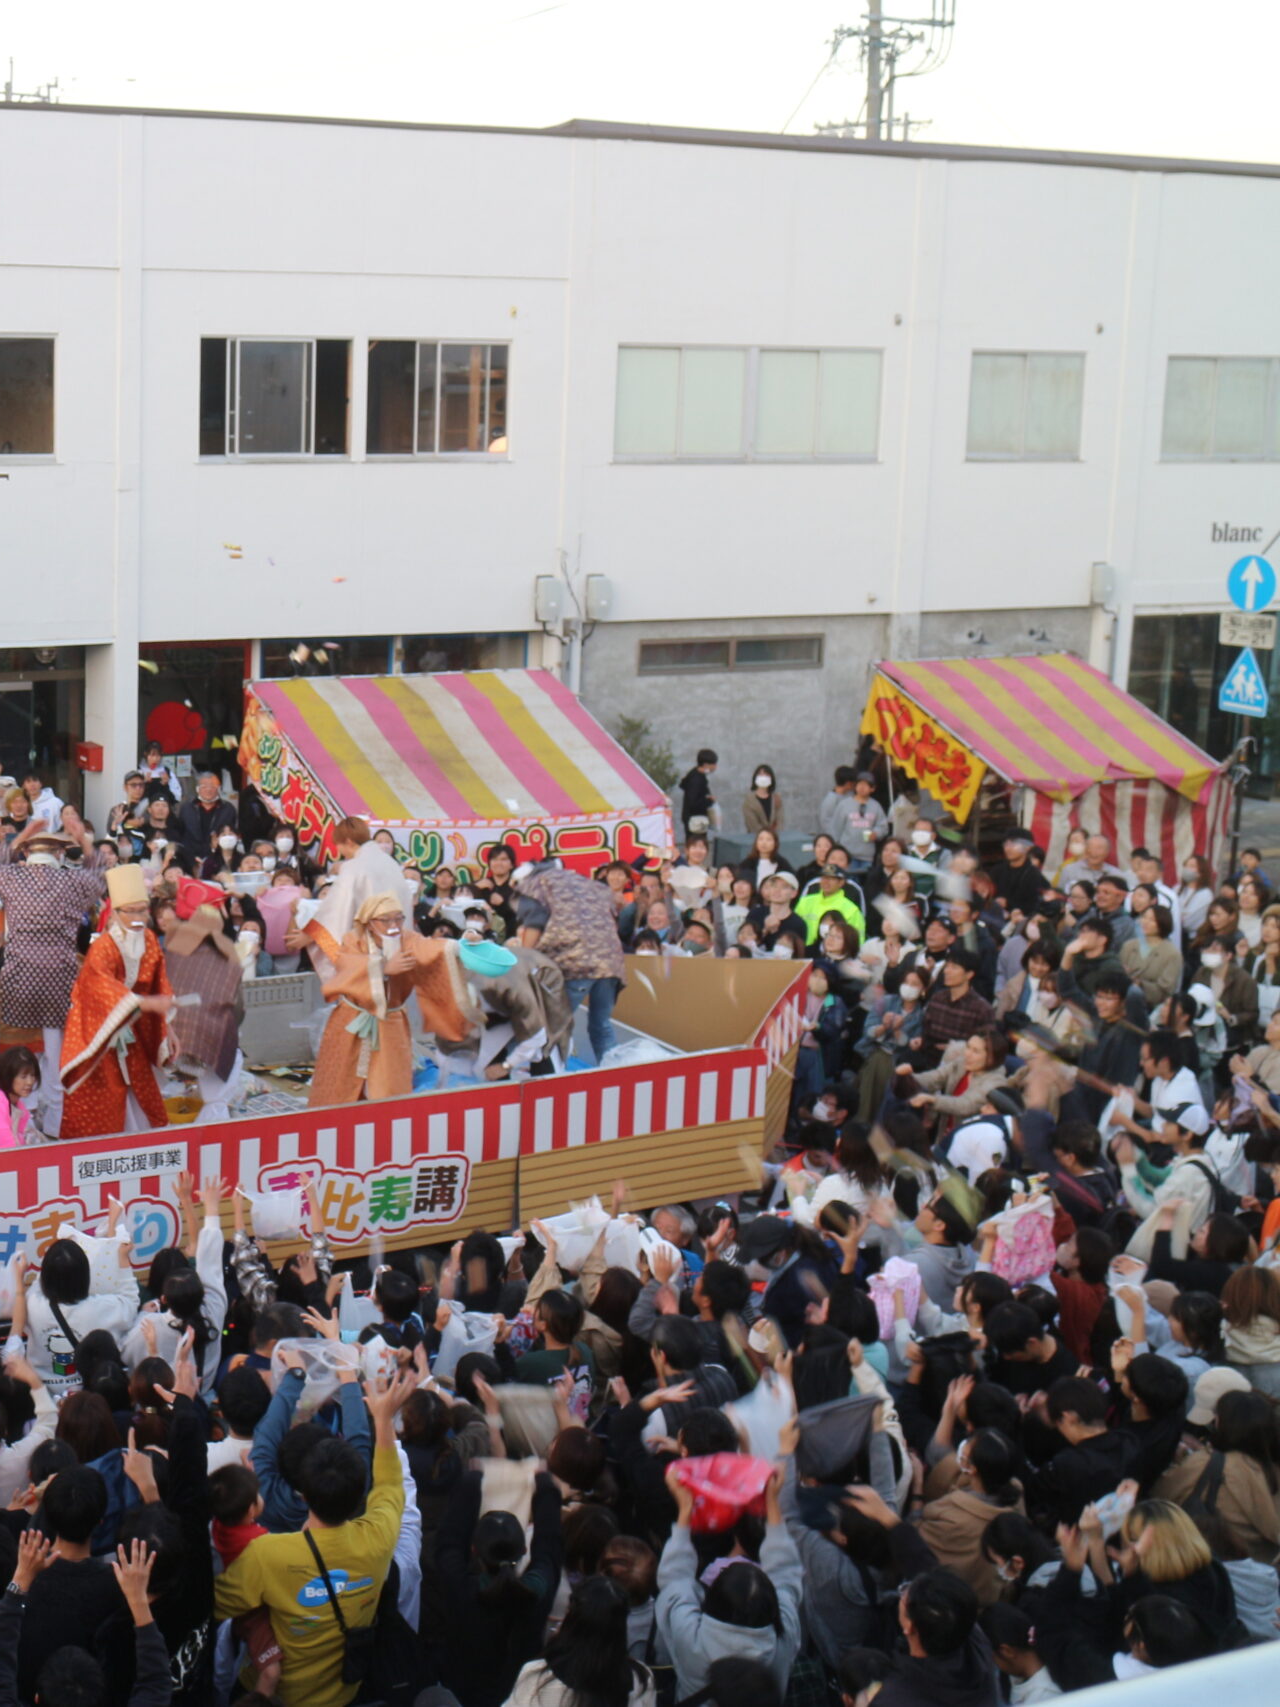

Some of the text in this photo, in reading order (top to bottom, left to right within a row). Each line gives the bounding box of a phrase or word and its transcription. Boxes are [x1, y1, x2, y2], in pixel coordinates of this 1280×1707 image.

[1211, 522, 1263, 542] blanc
[77, 1149, 182, 1179] 復興応援事業
